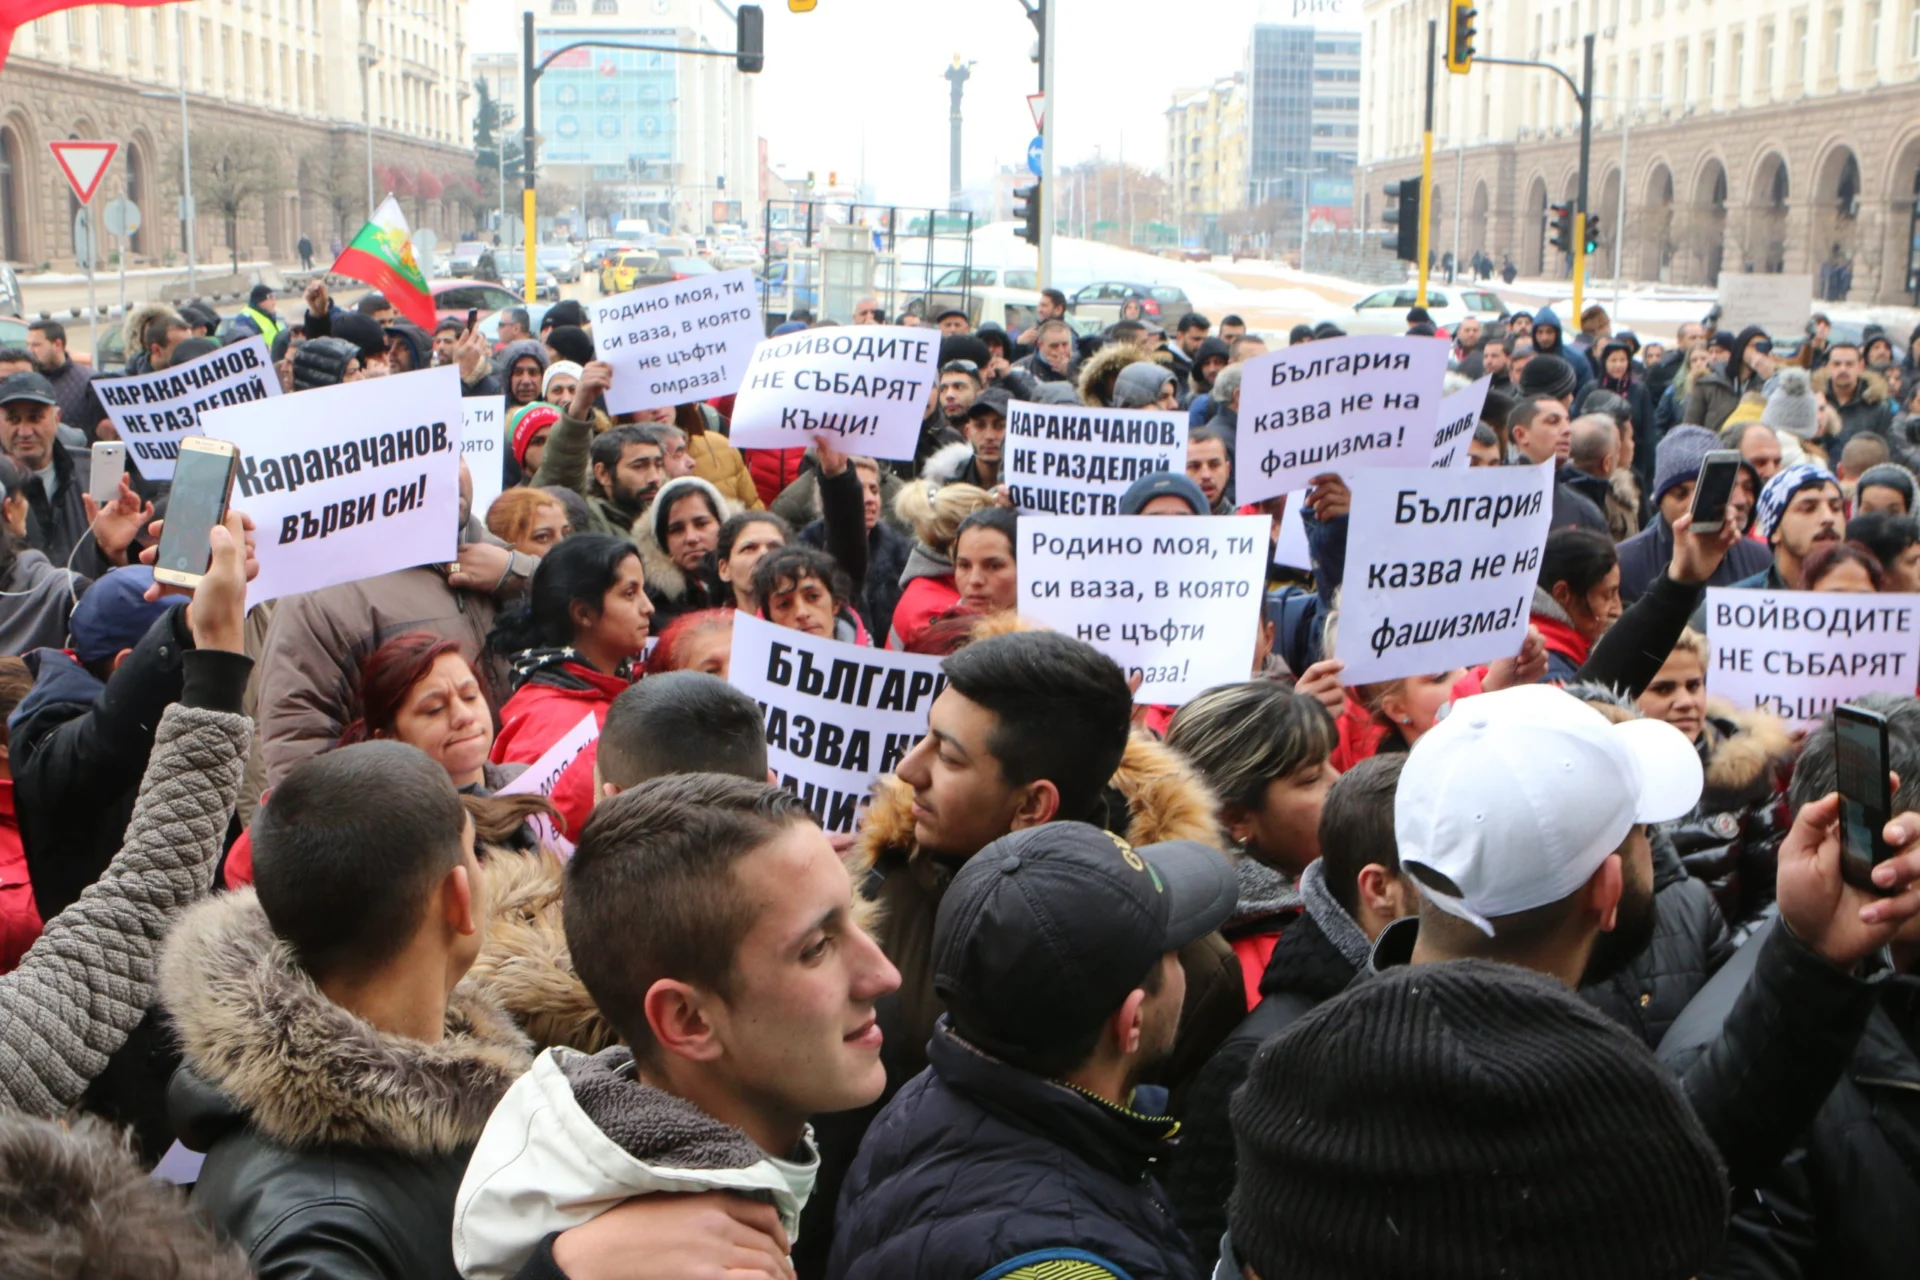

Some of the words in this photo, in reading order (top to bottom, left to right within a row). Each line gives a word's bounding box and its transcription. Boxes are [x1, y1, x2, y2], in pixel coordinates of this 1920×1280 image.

[599, 297, 669, 324] Родино
[674, 286, 719, 306] моя,
[723, 280, 744, 295] ти
[602, 336, 623, 351] си
[628, 324, 676, 345] ваза,
[681, 320, 693, 333] в
[699, 307, 751, 330] която
[638, 354, 661, 370] не
[667, 341, 727, 366] цъфти
[757, 335, 930, 364] ВОЙВОДИТЕ
[101, 347, 266, 406] КАРАКАЧАНОВ,
[650, 365, 727, 394] омраза!
[751, 370, 785, 390] НЕ
[794, 370, 922, 402] СЪБАРЯТ
[1270, 352, 1411, 387] България
[122, 414, 151, 434] НЕ
[781, 406, 879, 438] КЪЩИ!
[1010, 410, 1181, 450] КАРАКАЧАНОВ,
[1254, 400, 1331, 434] казва
[1340, 392, 1374, 415] не
[1383, 392, 1420, 411] на
[1433, 411, 1475, 449] анов,
[236, 421, 454, 498] Каракачанов,
[1013, 448, 1037, 474] НЕ
[1043, 452, 1170, 484] РАЗДЕЛЯЙ
[1260, 426, 1406, 478] фашизма!
[278, 493, 377, 545] върви
[382, 474, 427, 517] си!
[1009, 484, 1123, 516] ОБЩЕСТВ
[1395, 490, 1543, 528] България
[1032, 532, 1143, 560] Родино
[1152, 536, 1218, 560] моя,
[1226, 536, 1254, 555] ти
[1368, 558, 1462, 589] казва
[1470, 553, 1506, 580] не
[1512, 546, 1539, 575] на
[1031, 580, 1060, 598] си
[1070, 579, 1144, 602] ваза,
[1154, 580, 1169, 598] в
[1179, 579, 1250, 598] която
[1077, 623, 1111, 641] не
[1122, 618, 1205, 647] цъфти
[1371, 596, 1524, 659] фашизма!
[1717, 598, 1912, 638] ВОЙВОДИТЕ
[1121, 659, 1190, 684] раза!
[1719, 648, 1753, 672] НЕ
[1763, 650, 1906, 676] СЪБАРЯТ
[758, 701, 871, 773] АЗВА
